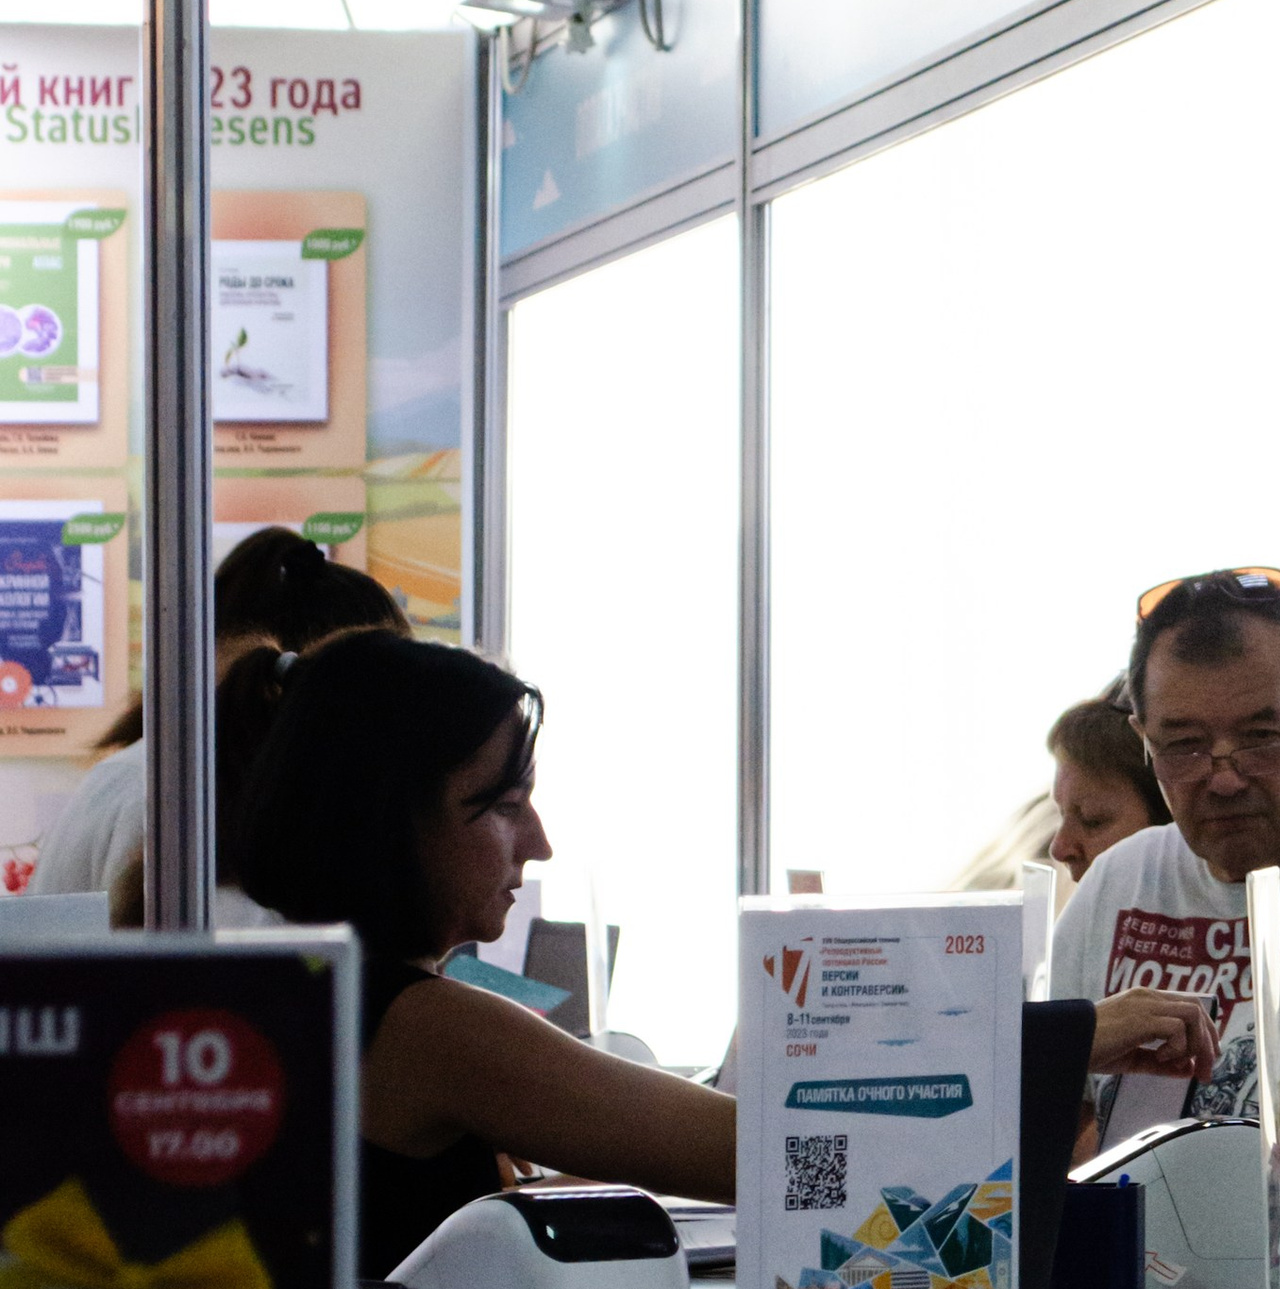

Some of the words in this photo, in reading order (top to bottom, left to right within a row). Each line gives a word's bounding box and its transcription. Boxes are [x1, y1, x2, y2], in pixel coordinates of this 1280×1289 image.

[39, 76, 134, 107] книг
[270, 76, 362, 116] года
[945, 935, 985, 954] 2023
[822, 970, 859, 981] ВЕРСИИ
[822, 985, 828, 997] И
[811, 1015, 850, 1026] сентября
[152, 1027, 232, 1088] 10
[786, 1044, 817, 1057] СОЧИ
[797, 1088, 854, 1104] ПАМЯТКА
[858, 1085, 904, 1101] ОЧНОГО
[907, 1083, 963, 1100] УЧАСТИЯ
